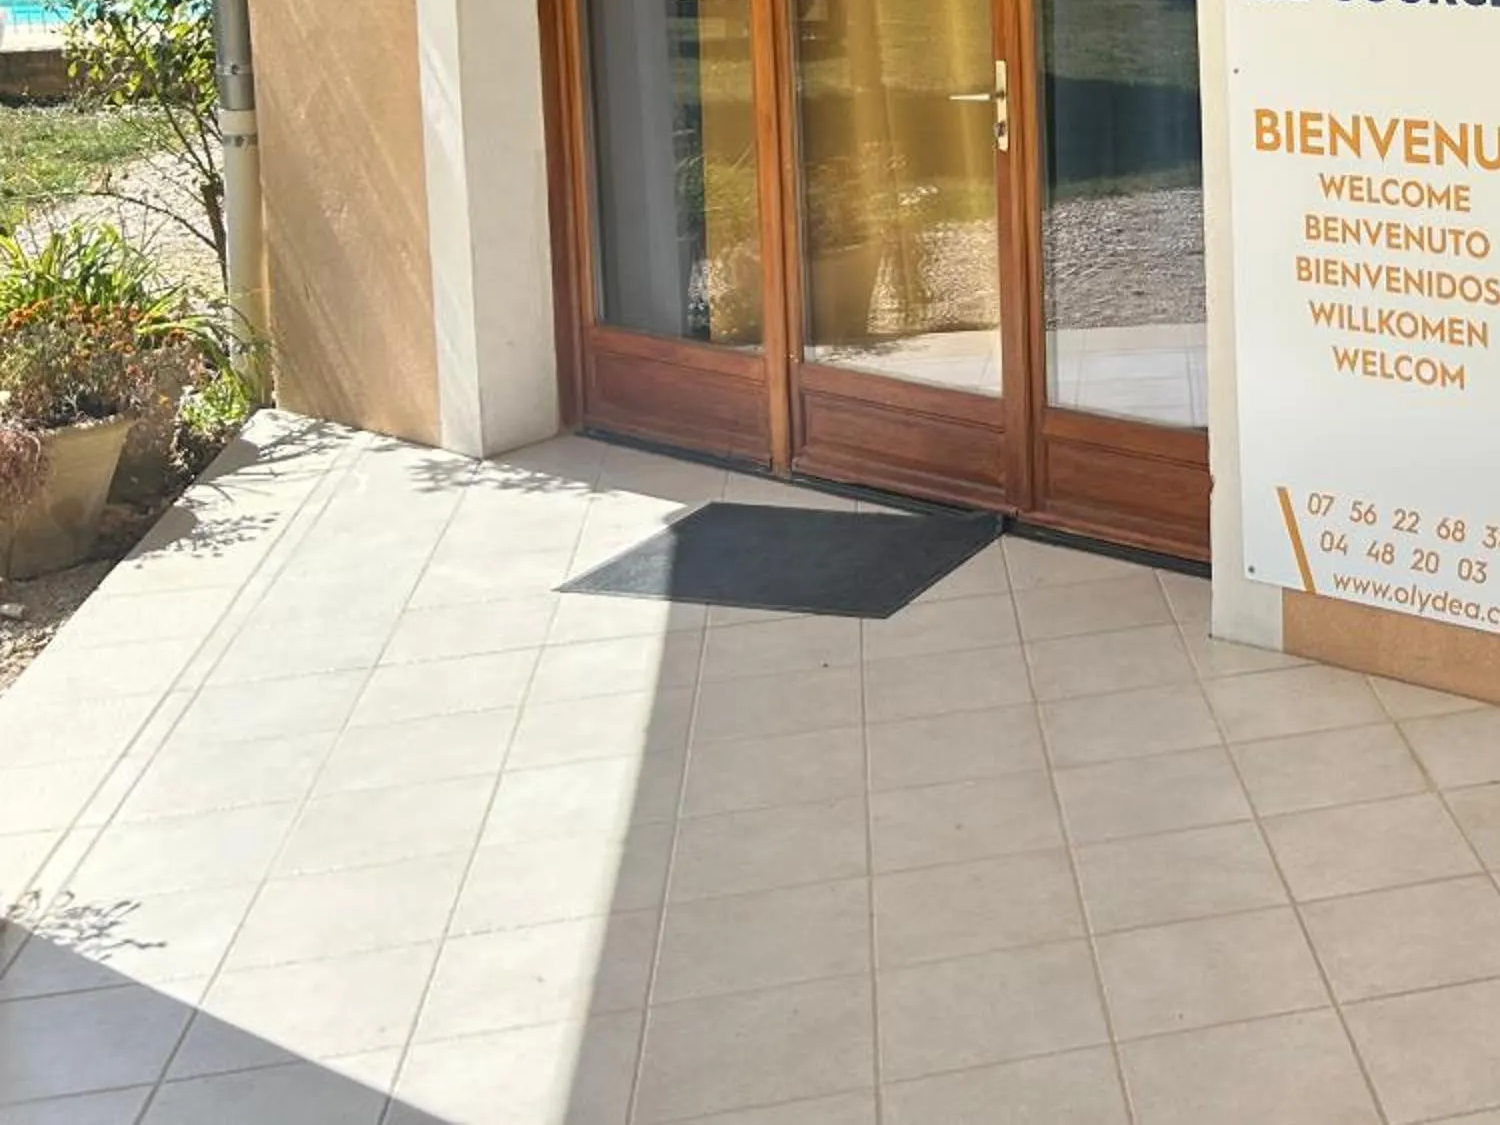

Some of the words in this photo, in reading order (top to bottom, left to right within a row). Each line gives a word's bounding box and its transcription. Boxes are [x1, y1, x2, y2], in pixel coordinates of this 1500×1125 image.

[1318, 172, 1472, 212] WELCOME
[1304, 213, 1491, 259] BENVENUTO
[1308, 300, 1489, 348] WILLKOMEN
[1331, 345, 1466, 389] WELCOM
[1306, 492, 1335, 517] 07
[1349, 500, 1378, 525] 56
[1392, 508, 1421, 534] 22
[1436, 517, 1466, 542] 68
[1319, 530, 1349, 556] 04
[1366, 540, 1396, 565] 48
[1411, 548, 1439, 574] 20
[1457, 557, 1488, 584] 03
